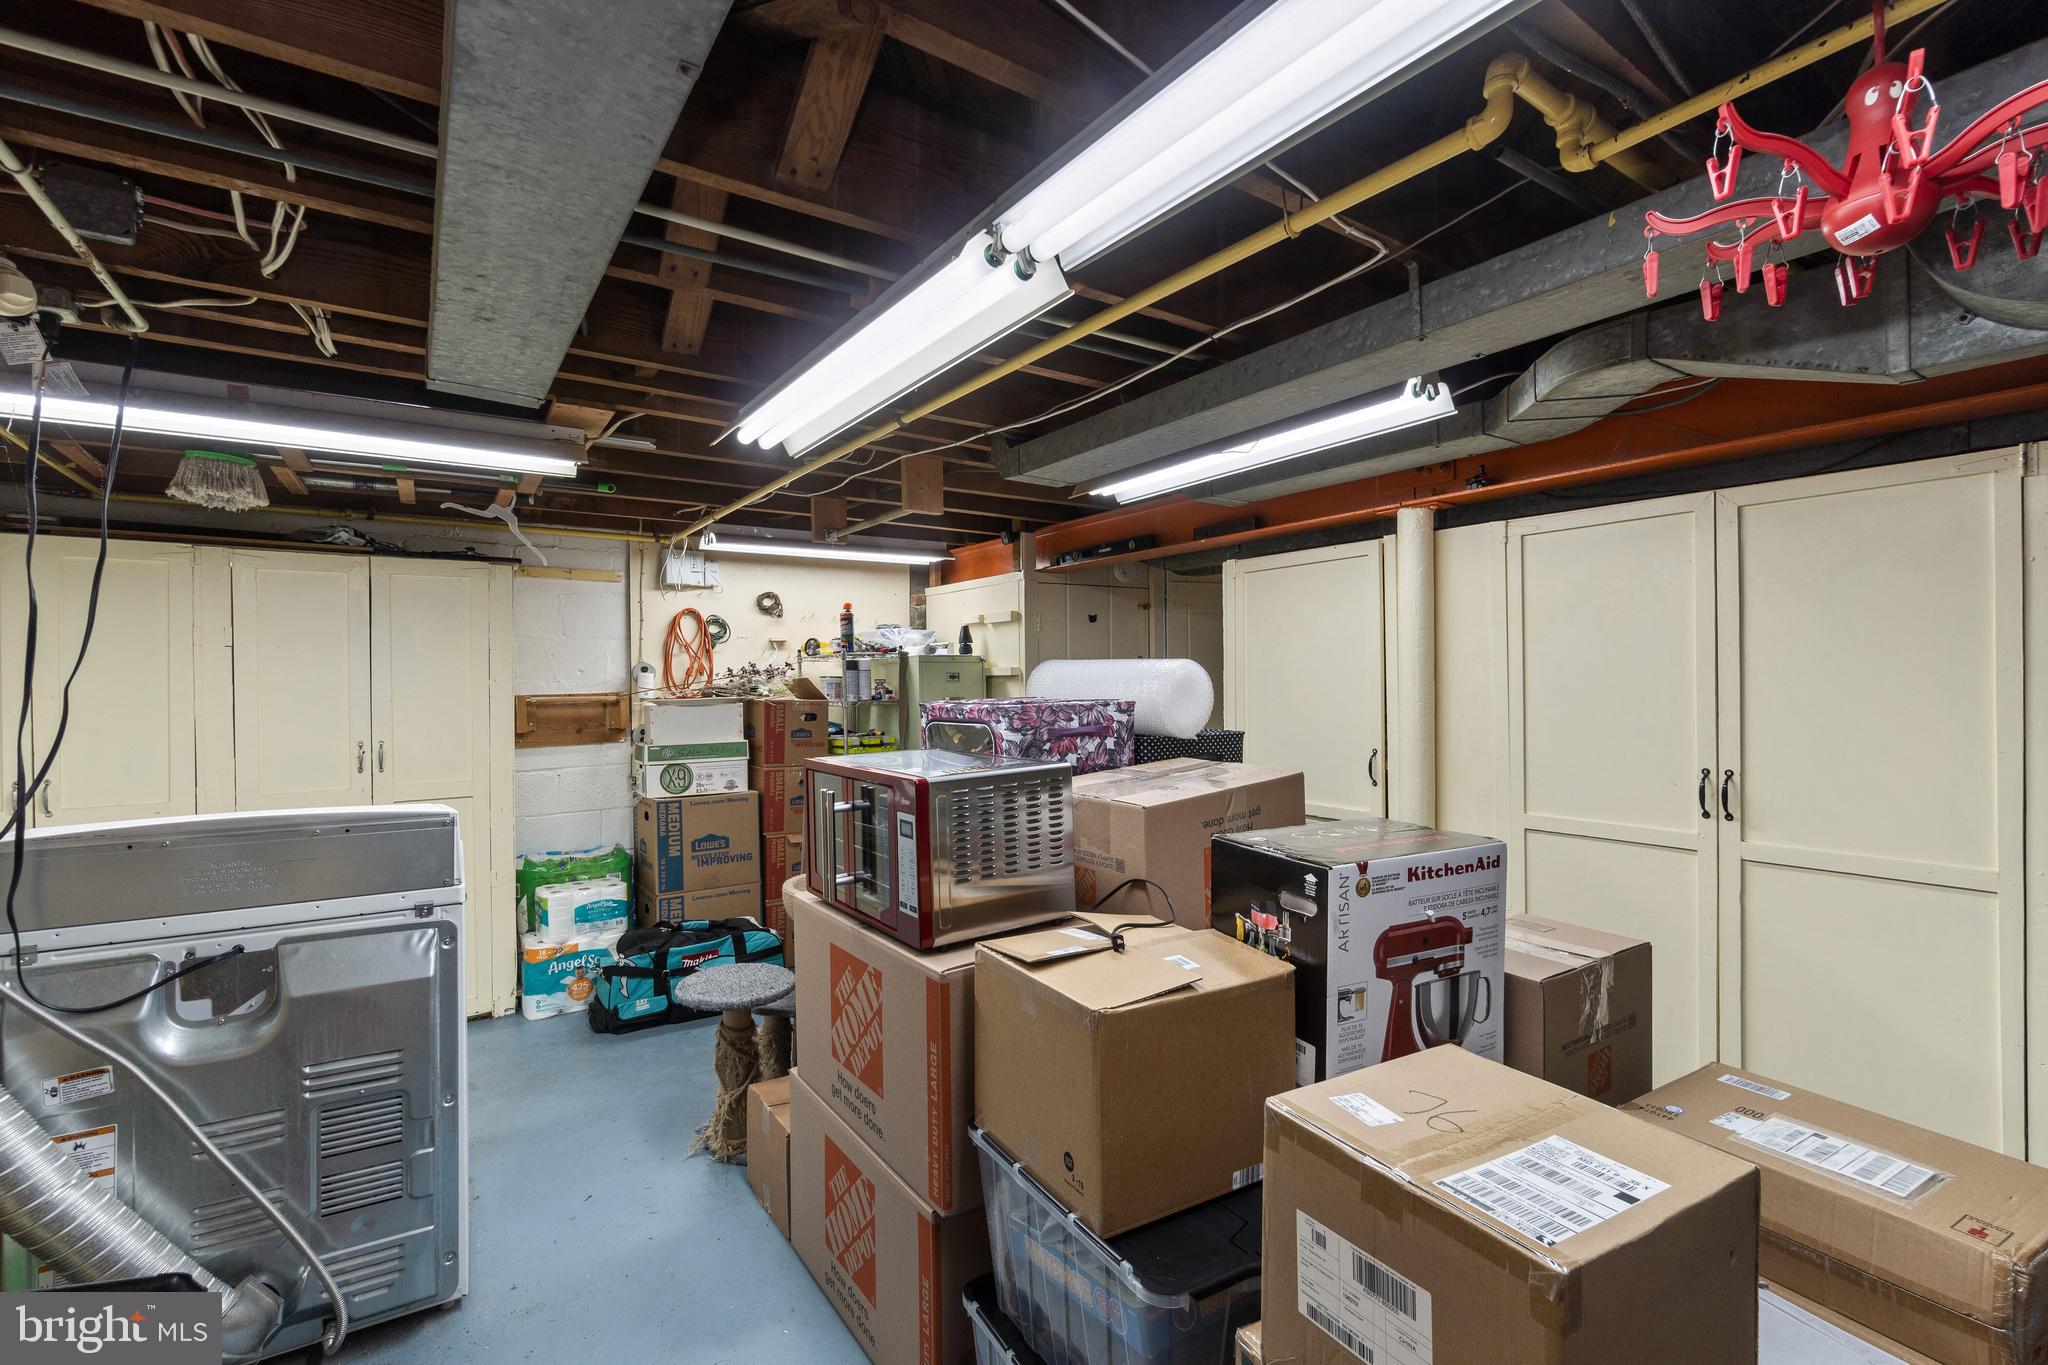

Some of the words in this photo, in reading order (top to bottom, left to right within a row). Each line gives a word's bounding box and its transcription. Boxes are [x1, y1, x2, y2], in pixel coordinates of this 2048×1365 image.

[776, 703, 784, 733] SMALL
[776, 770, 784, 802] SMALL
[668, 802, 681, 857] MEDIUM
[695, 839, 726, 850] LOWE'S
[697, 852, 752, 867] IMPROVING
[777, 837, 785, 868] SMALL
[1407, 854, 1501, 883] KitchenAid
[1408, 897, 1431, 907] BATTEUR
[1431, 895, 1440, 903] SUR
[1441, 892, 1457, 901] SOCLE
[1475, 884, 1500, 894] INCLINABLE
[1424, 902, 1448, 911] BATIDORA
[1456, 896, 1474, 906] CABEZA
[1475, 892, 1500, 901] INCLINABLE
[1481, 906, 1490, 917] 4,7
[1462, 911, 1466, 920] 5
[547, 955, 588, 976] Angel
[834, 965, 856, 1007] THE
[831, 964, 882, 1065] HOME
[850, 1016, 882, 1078] DEPOT
[930, 1041, 938, 1101] LARGE
[837, 1069, 853, 1094] How
[854, 1085, 877, 1115] doers
[831, 1083, 843, 1102] get
[843, 1094, 862, 1120] more
[863, 1112, 886, 1143] done.
[829, 1165, 849, 1202] THE
[825, 1174, 875, 1257] HOME
[844, 1227, 875, 1278] DEPOT
[830, 1261, 846, 1288] How
[847, 1285, 869, 1321] doers
[824, 1271, 836, 1295] get
[836, 1288, 855, 1318] more
[856, 1315, 878, 1351] done.
[1398, 1335, 1417, 1352] CHINA
